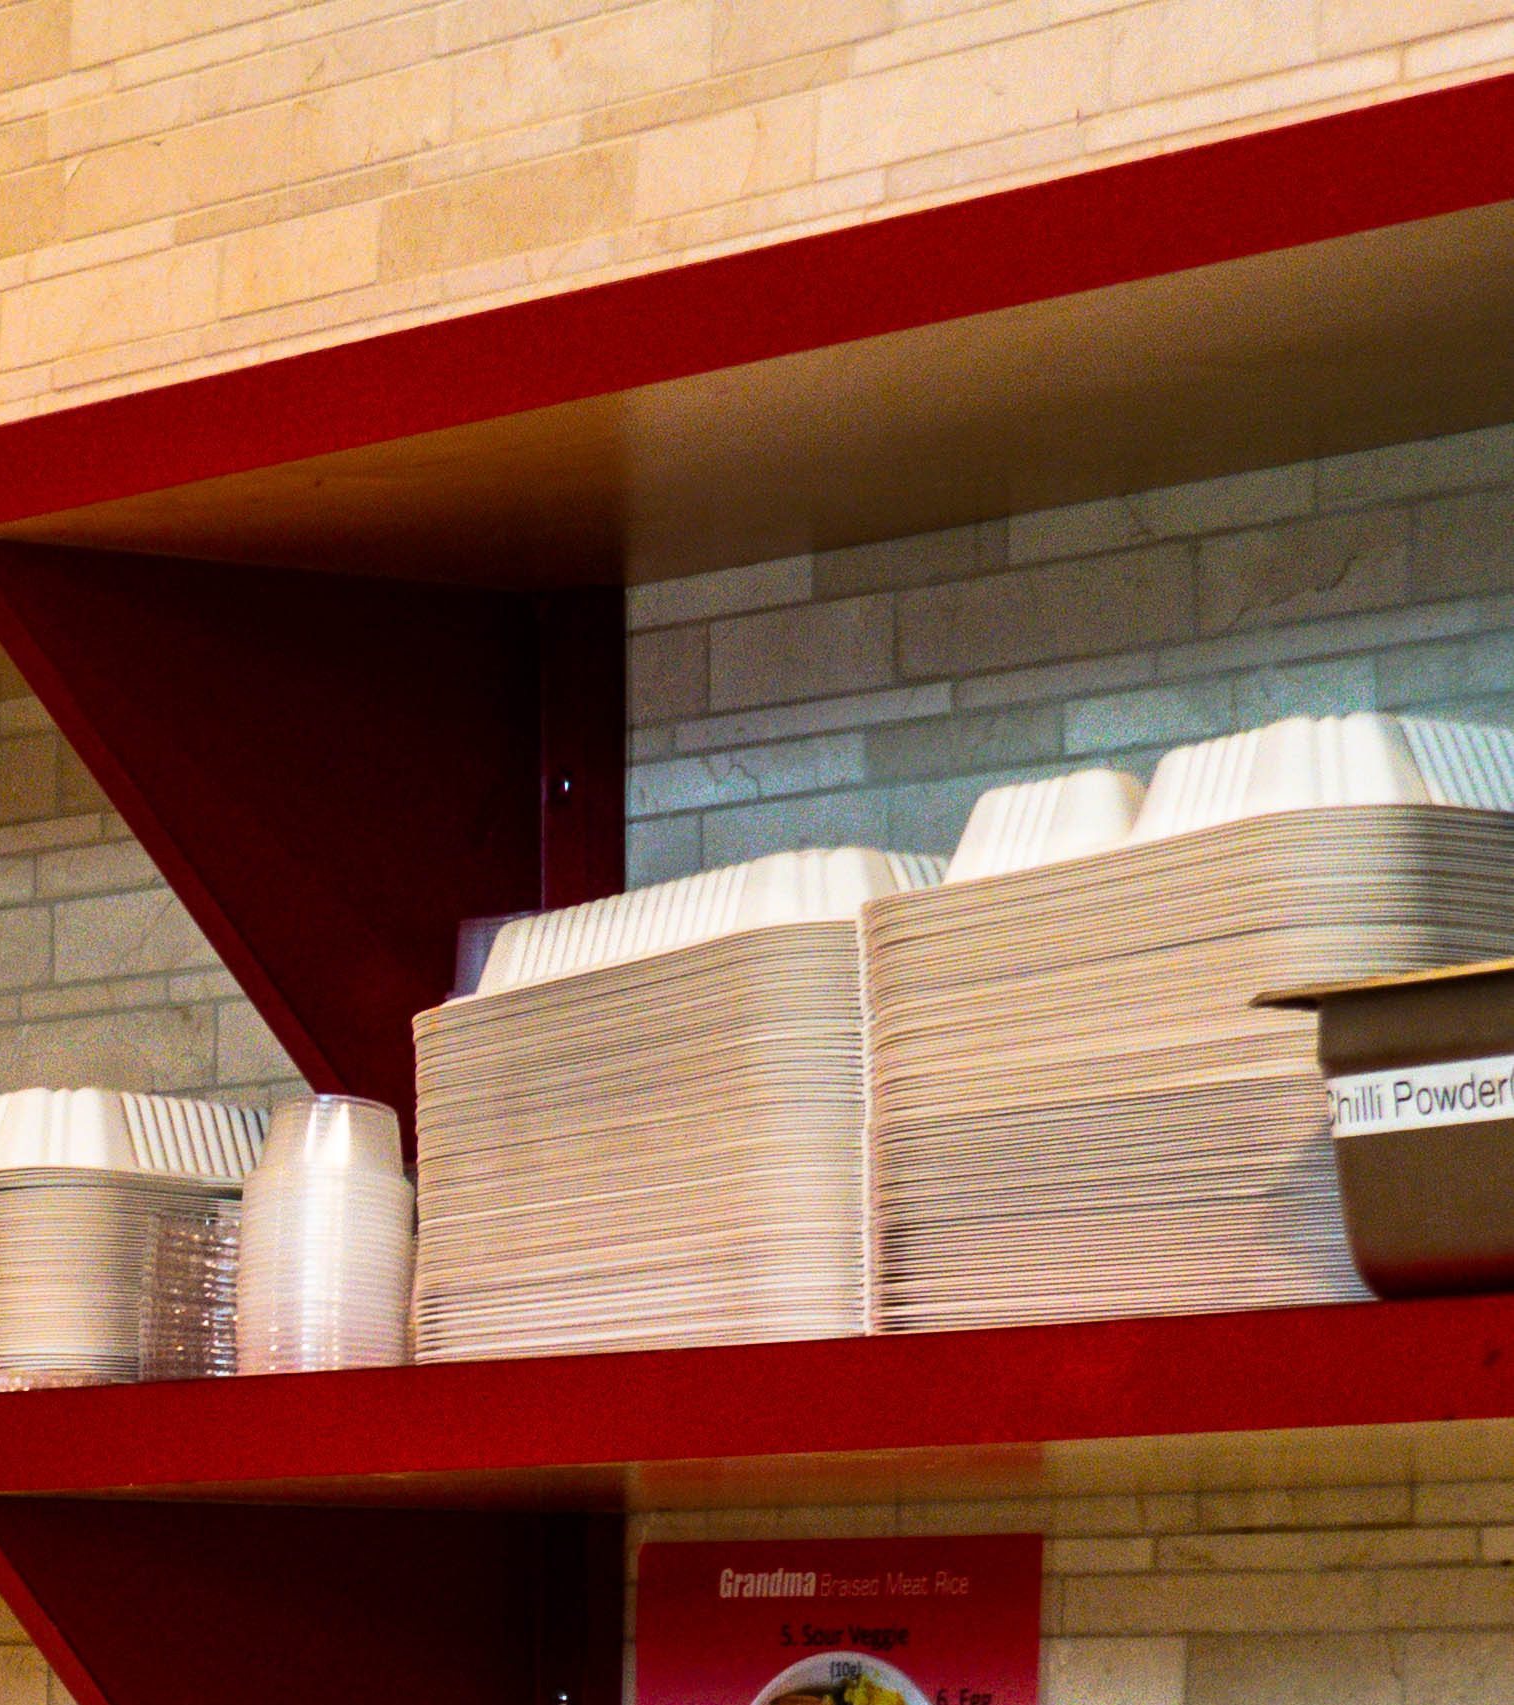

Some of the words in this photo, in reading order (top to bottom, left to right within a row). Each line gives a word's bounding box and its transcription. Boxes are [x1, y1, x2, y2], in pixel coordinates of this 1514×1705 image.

[1393, 1072, 1509, 1118] Powder
[719, 1567, 816, 1599] Grandma
[820, 1572, 880, 1597] Braised
[885, 1572, 927, 1596] Meat
[934, 1570, 969, 1595] Rice
[781, 1625, 798, 1647] 5.
[802, 1625, 843, 1647] Sour
[847, 1624, 910, 1650] Veggie
